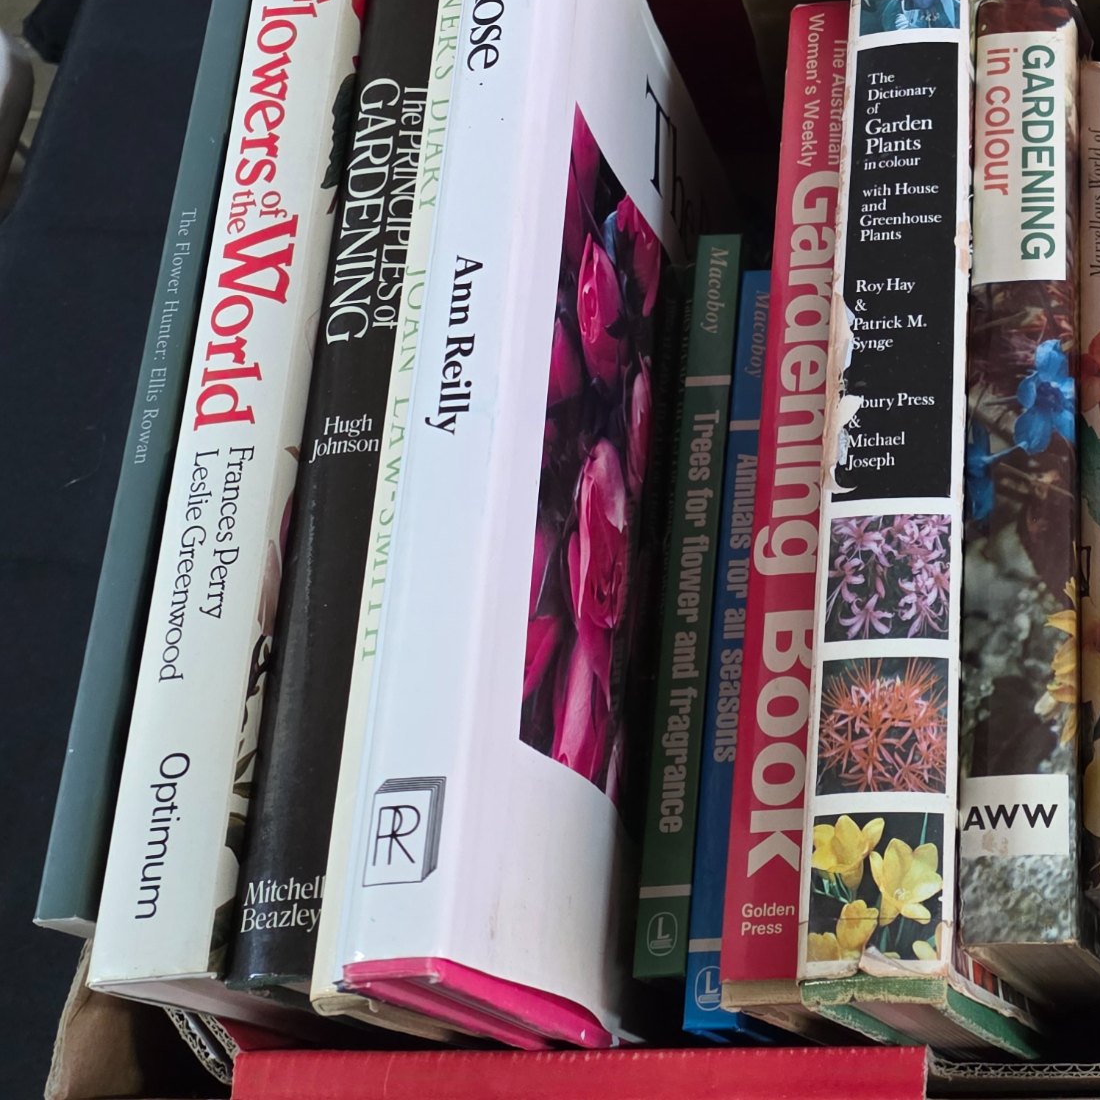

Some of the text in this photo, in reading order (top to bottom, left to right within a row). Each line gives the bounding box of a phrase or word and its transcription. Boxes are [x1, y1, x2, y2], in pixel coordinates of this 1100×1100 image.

[797, 13, 825, 168] Women's Weekly
[868, 73, 895, 85] The
[868, 86, 937, 101] Dictionary
[865, 115, 933, 135] Garden
[983, 85, 1015, 196] colour
[865, 136, 922, 155] Plants
[1020, 44, 1056, 261] GARDENING
[878, 156, 921, 170] colour
[862, 182, 940, 197] with House
[325, 77, 401, 345] GARDENING
[859, 211, 942, 227] Greenhouse
[371, 130, 422, 331] PRINCIPLES of
[398, 99, 451, 372] DIARY JOAN
[860, 229, 902, 242] Plants
[701, 246, 730, 335] Macoboy
[856, 278, 915, 294] Roy Hay
[192, 213, 299, 431] World
[853, 316, 903, 331] Patrick
[132, 244, 191, 465] Flower Hunter: Ellis Rowan
[425, 254, 484, 436] Ann Reilly
[897, 393, 935, 407] Press
[323, 414, 373, 438] Hugh
[847, 431, 906, 448] Michael
[308, 439, 380, 463] Johnson
[689, 410, 720, 481] Trees
[845, 455, 895, 471] Joseph
[686, 487, 714, 526] for
[199, 446, 255, 620] Frances Perry
[747, 170, 841, 878] Gardening BOOK
[157, 448, 219, 683] Leslie Greenwood
[677, 532, 711, 624] flower
[671, 631, 698, 679] and
[713, 648, 743, 763] seasons
[659, 688, 697, 833] fragrance
[963, 804, 1058, 831] AWW
[133, 752, 191, 921] Optimum
[244, 876, 326, 905] Mitchell
[240, 905, 322, 934] Beazley
[742, 902, 795, 918] Golden
[741, 921, 783, 937] Press
